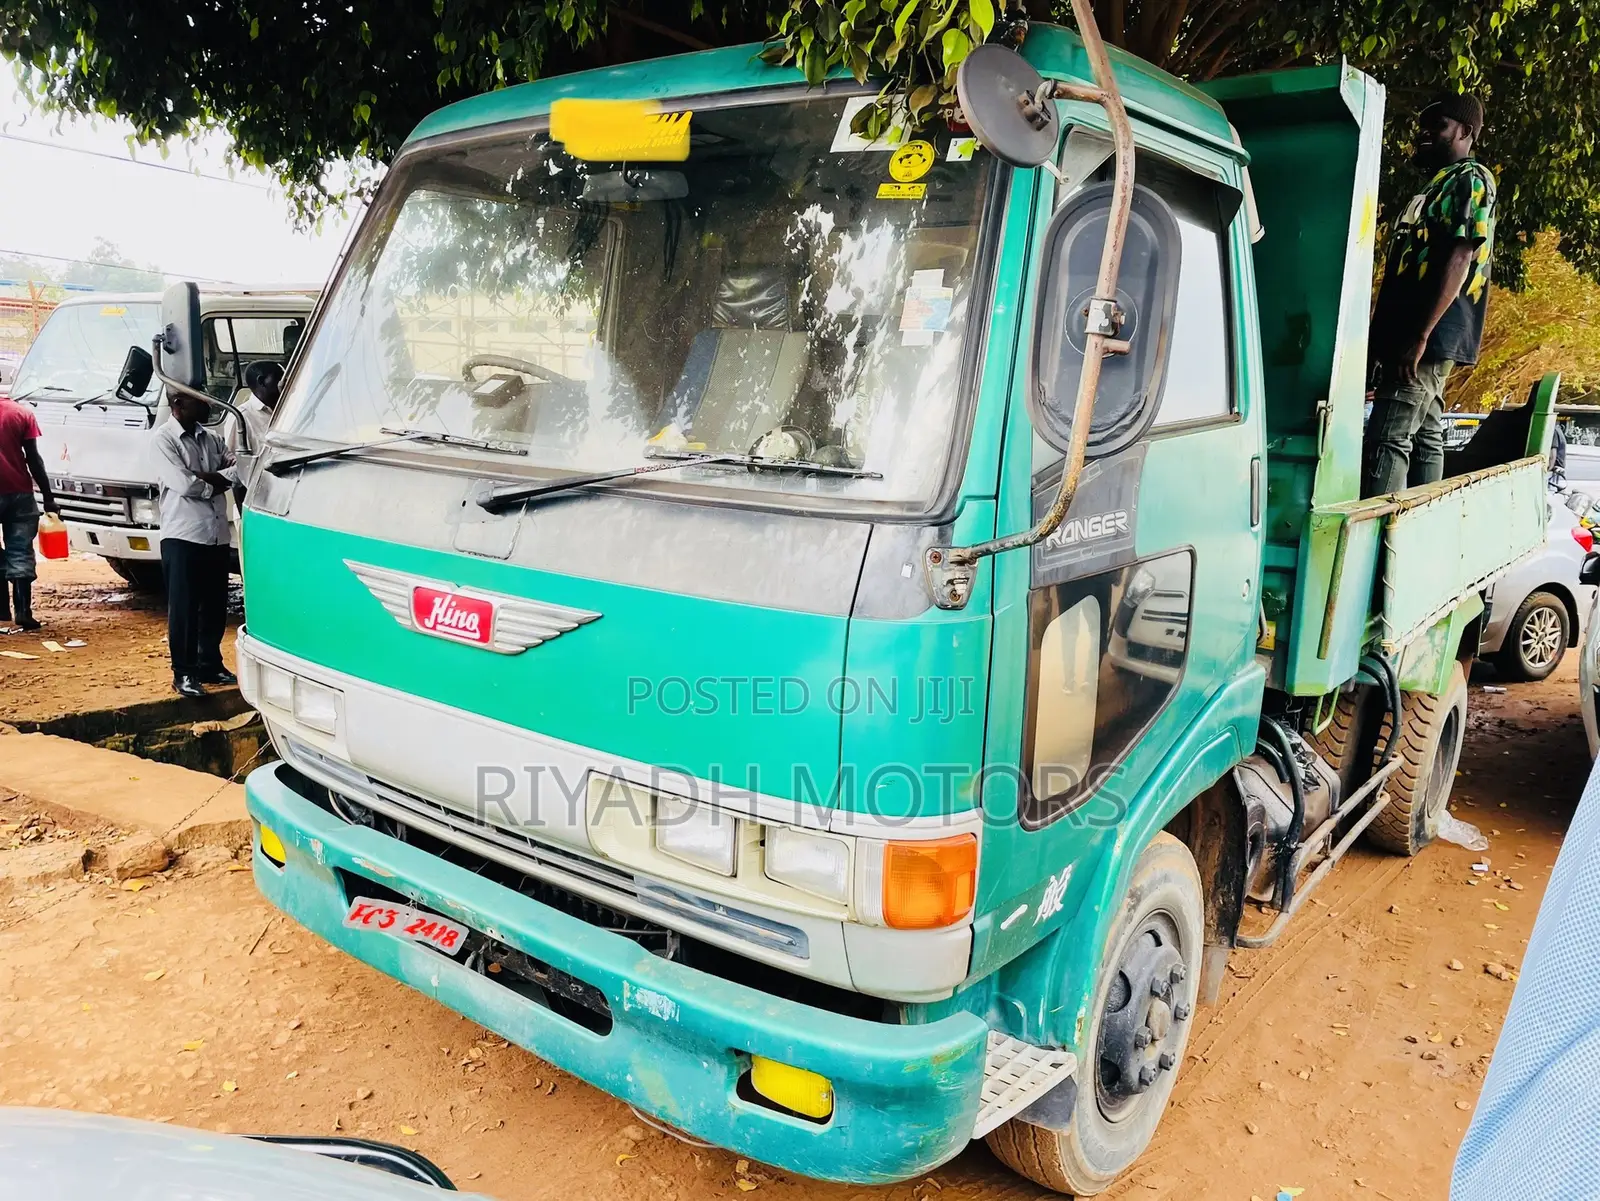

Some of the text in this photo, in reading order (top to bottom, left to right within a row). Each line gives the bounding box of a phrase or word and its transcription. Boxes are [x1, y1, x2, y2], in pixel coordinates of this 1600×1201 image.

[55, 478, 103, 496] USO
[1045, 510, 1129, 549] RANGER
[424, 594, 481, 640] Hino
[403, 917, 460, 948] 2418
